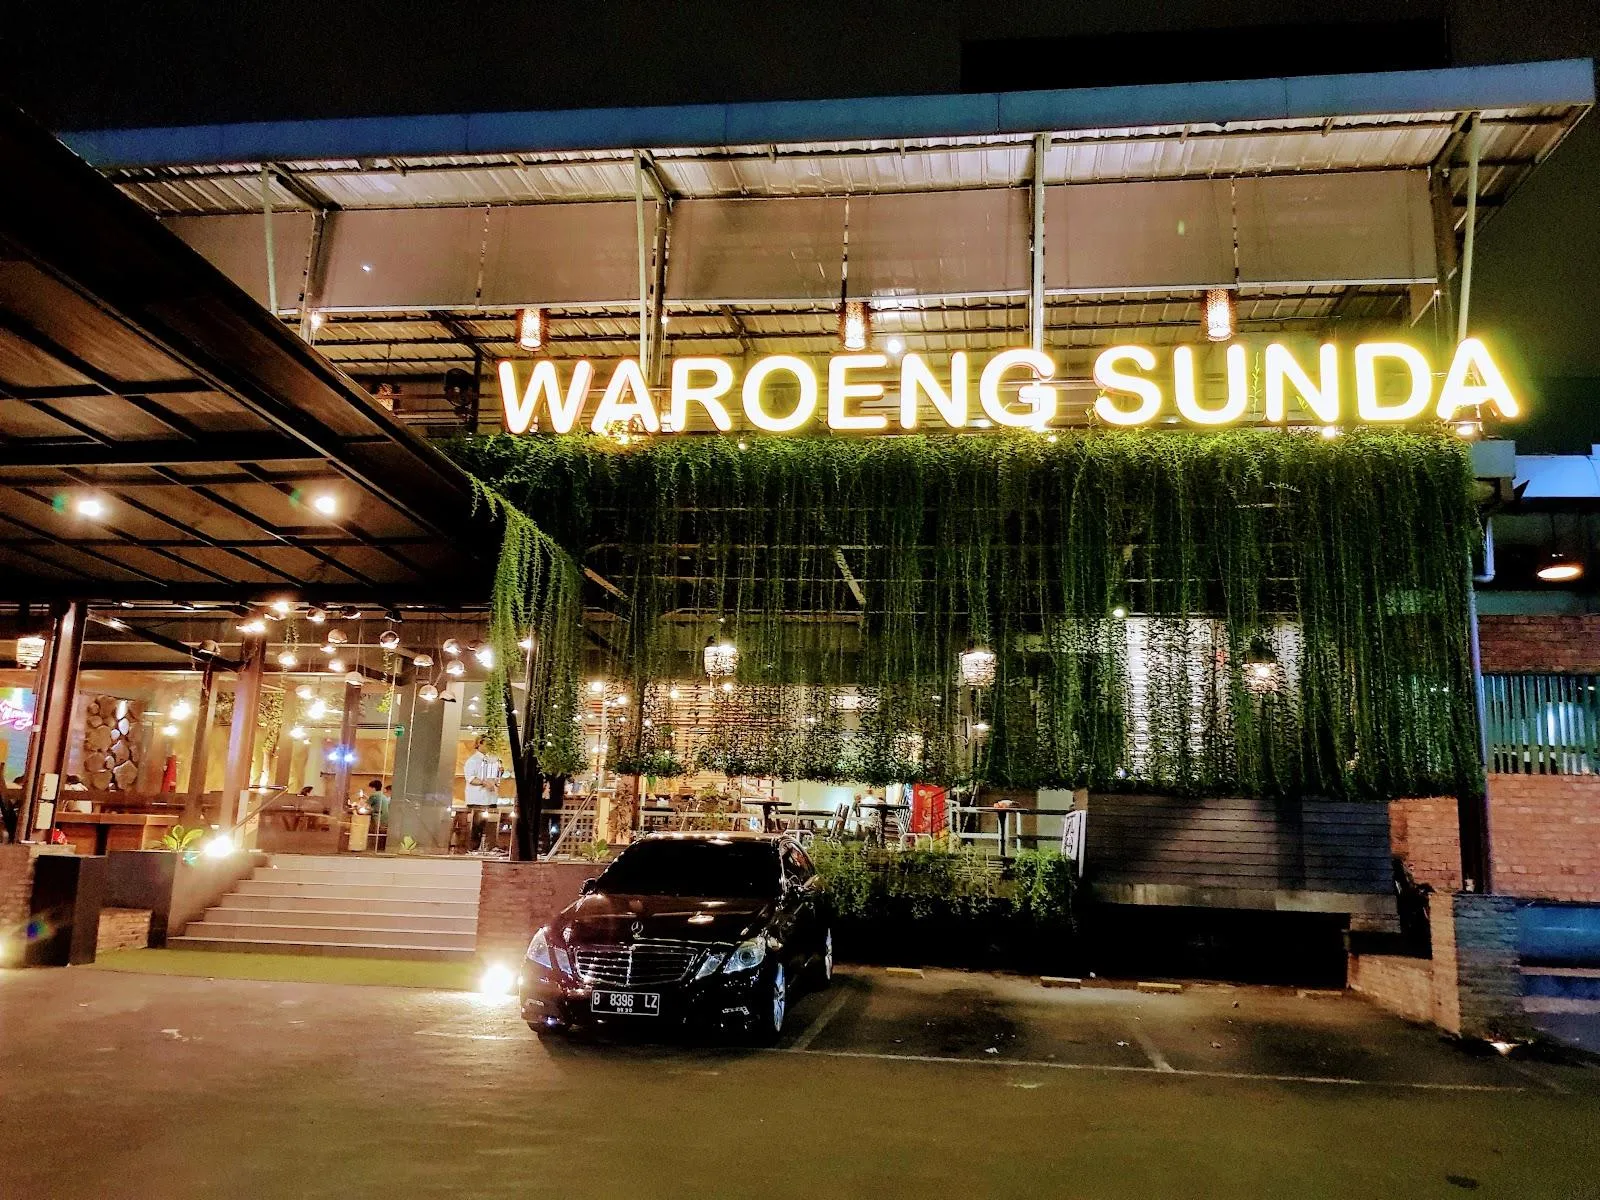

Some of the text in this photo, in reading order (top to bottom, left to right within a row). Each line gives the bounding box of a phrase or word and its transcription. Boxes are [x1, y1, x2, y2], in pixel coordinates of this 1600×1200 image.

[497, 338, 1521, 434] WAROENG SUNDA
[593, 992, 658, 1008] B 8396 LZ
